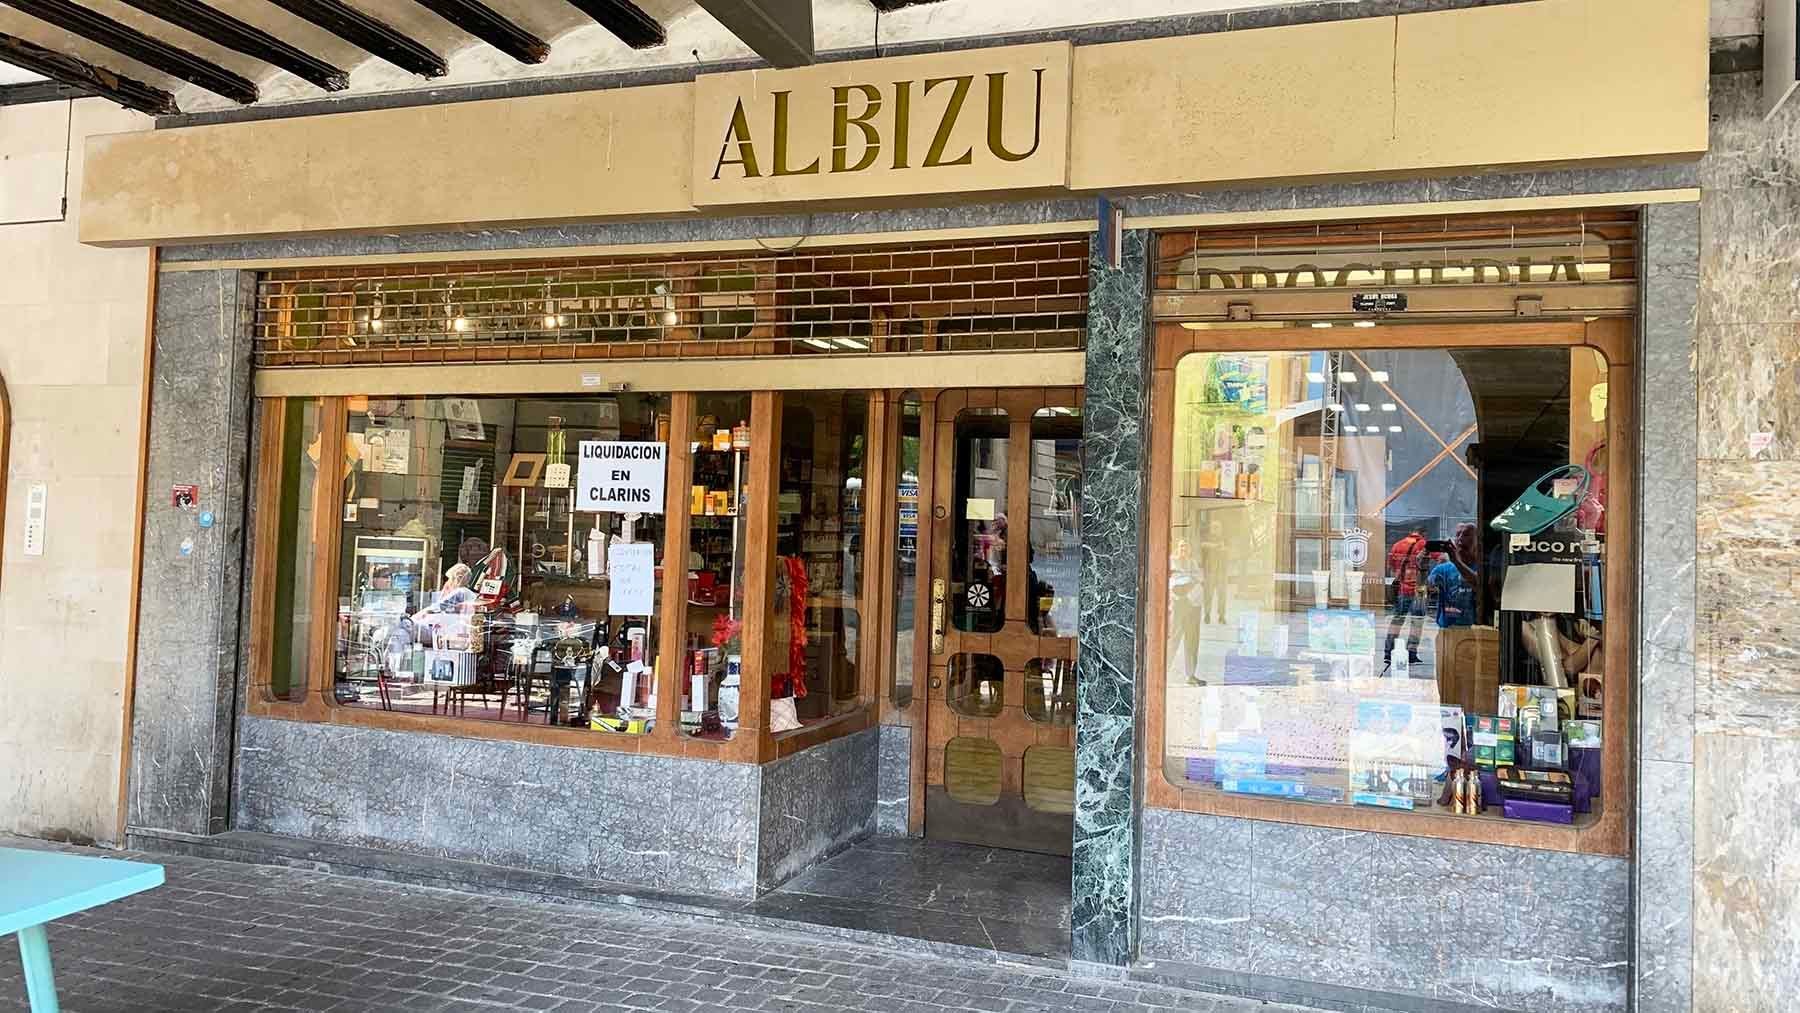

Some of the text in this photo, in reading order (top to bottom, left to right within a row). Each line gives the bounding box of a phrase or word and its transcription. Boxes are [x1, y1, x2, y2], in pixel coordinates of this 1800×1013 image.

[711, 68, 1047, 180] ALBIZU
[583, 445, 661, 460] LIQUIDACION
[611, 470, 631, 481] EN
[590, 487, 651, 502] CLARINS
[901, 489, 918, 497] VISA
